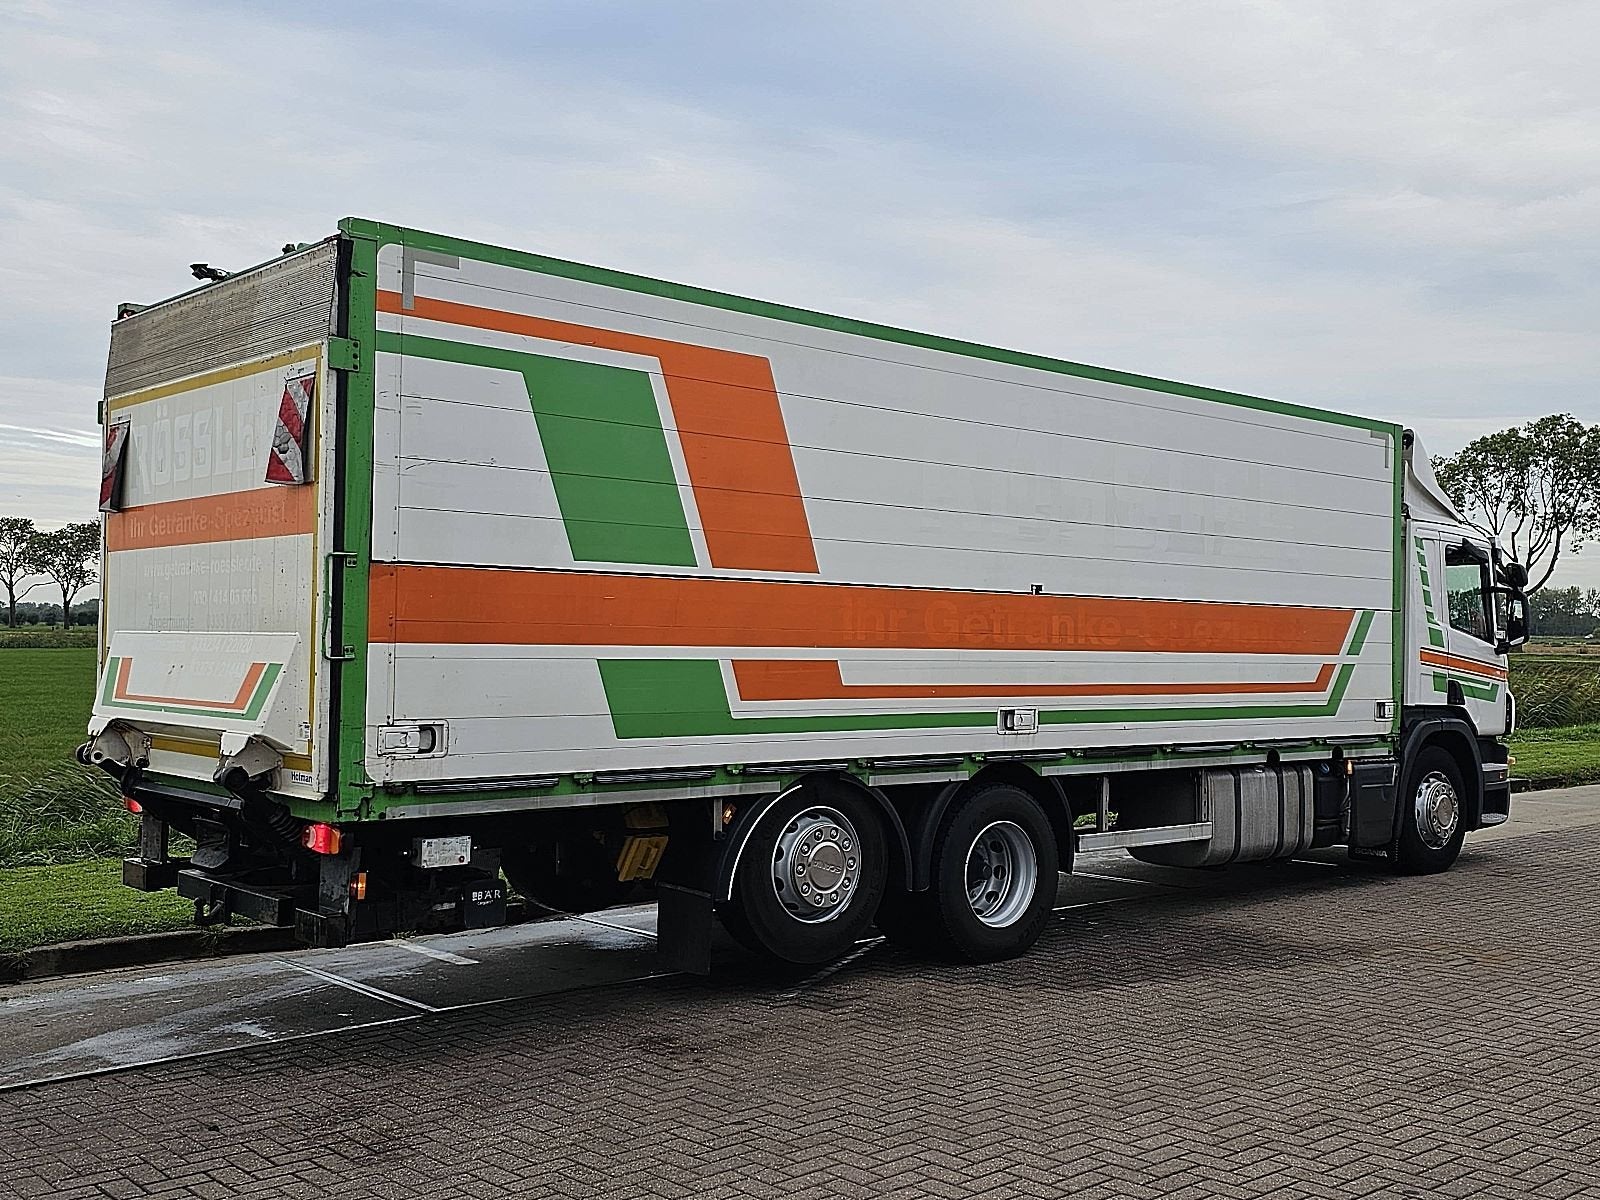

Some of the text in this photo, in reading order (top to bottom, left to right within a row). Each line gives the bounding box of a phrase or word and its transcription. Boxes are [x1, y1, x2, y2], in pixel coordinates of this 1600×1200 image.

[130, 517, 145, 538] Ihr
[841, 597, 909, 644] Ihr
[1354, 847, 1388, 858] SCANIA
